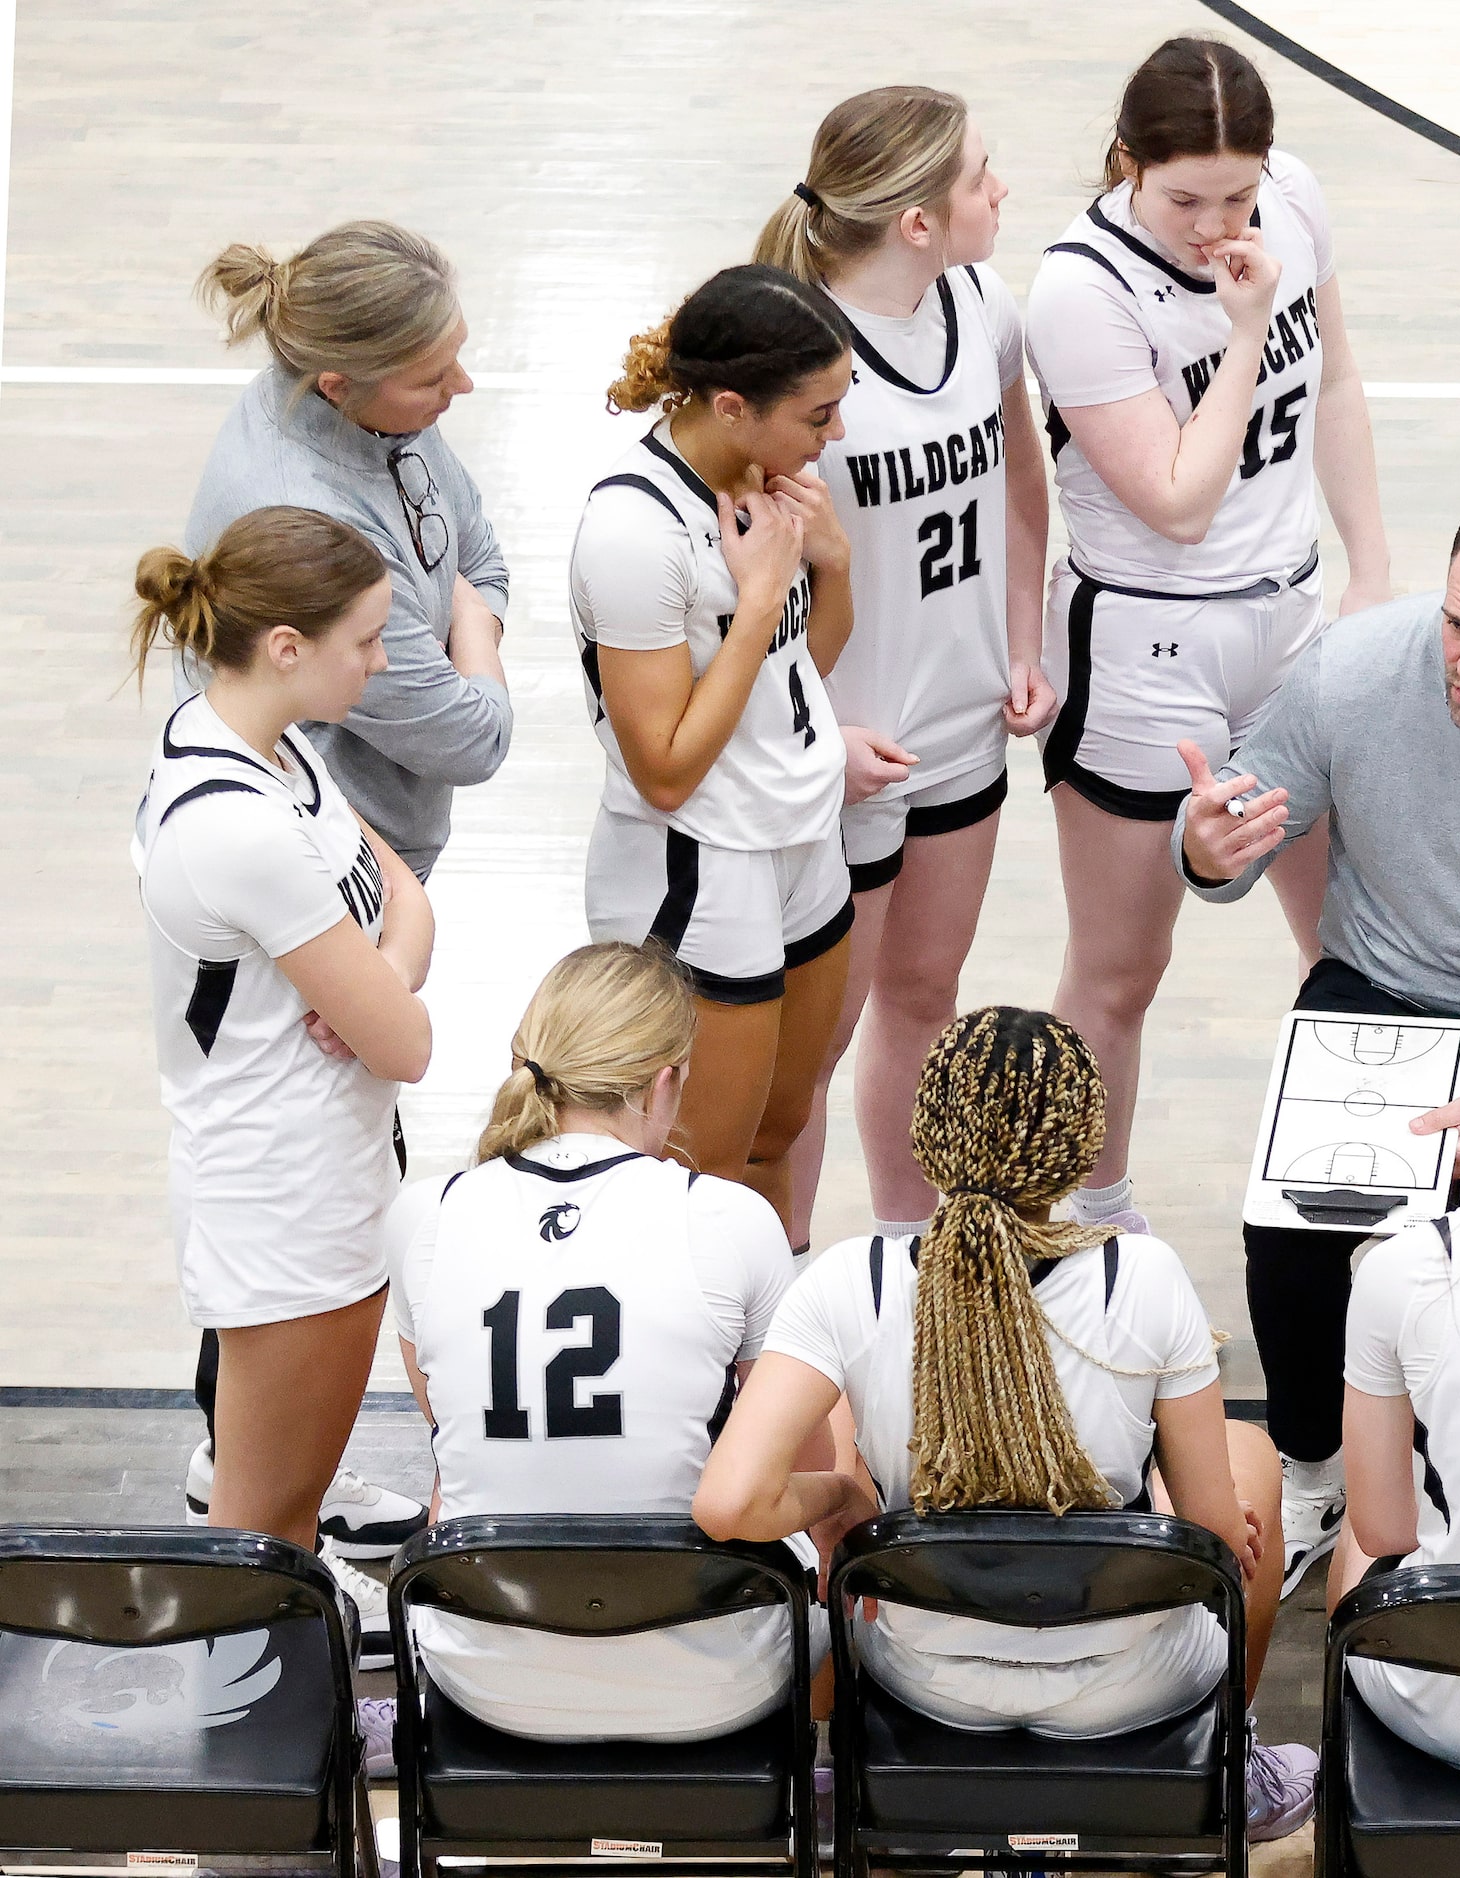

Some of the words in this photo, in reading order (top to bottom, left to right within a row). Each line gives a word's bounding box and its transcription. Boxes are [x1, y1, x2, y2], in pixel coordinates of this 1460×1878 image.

[1239, 382, 1308, 480] 15
[917, 499, 982, 602] 21
[482, 1283, 625, 1441] 12
